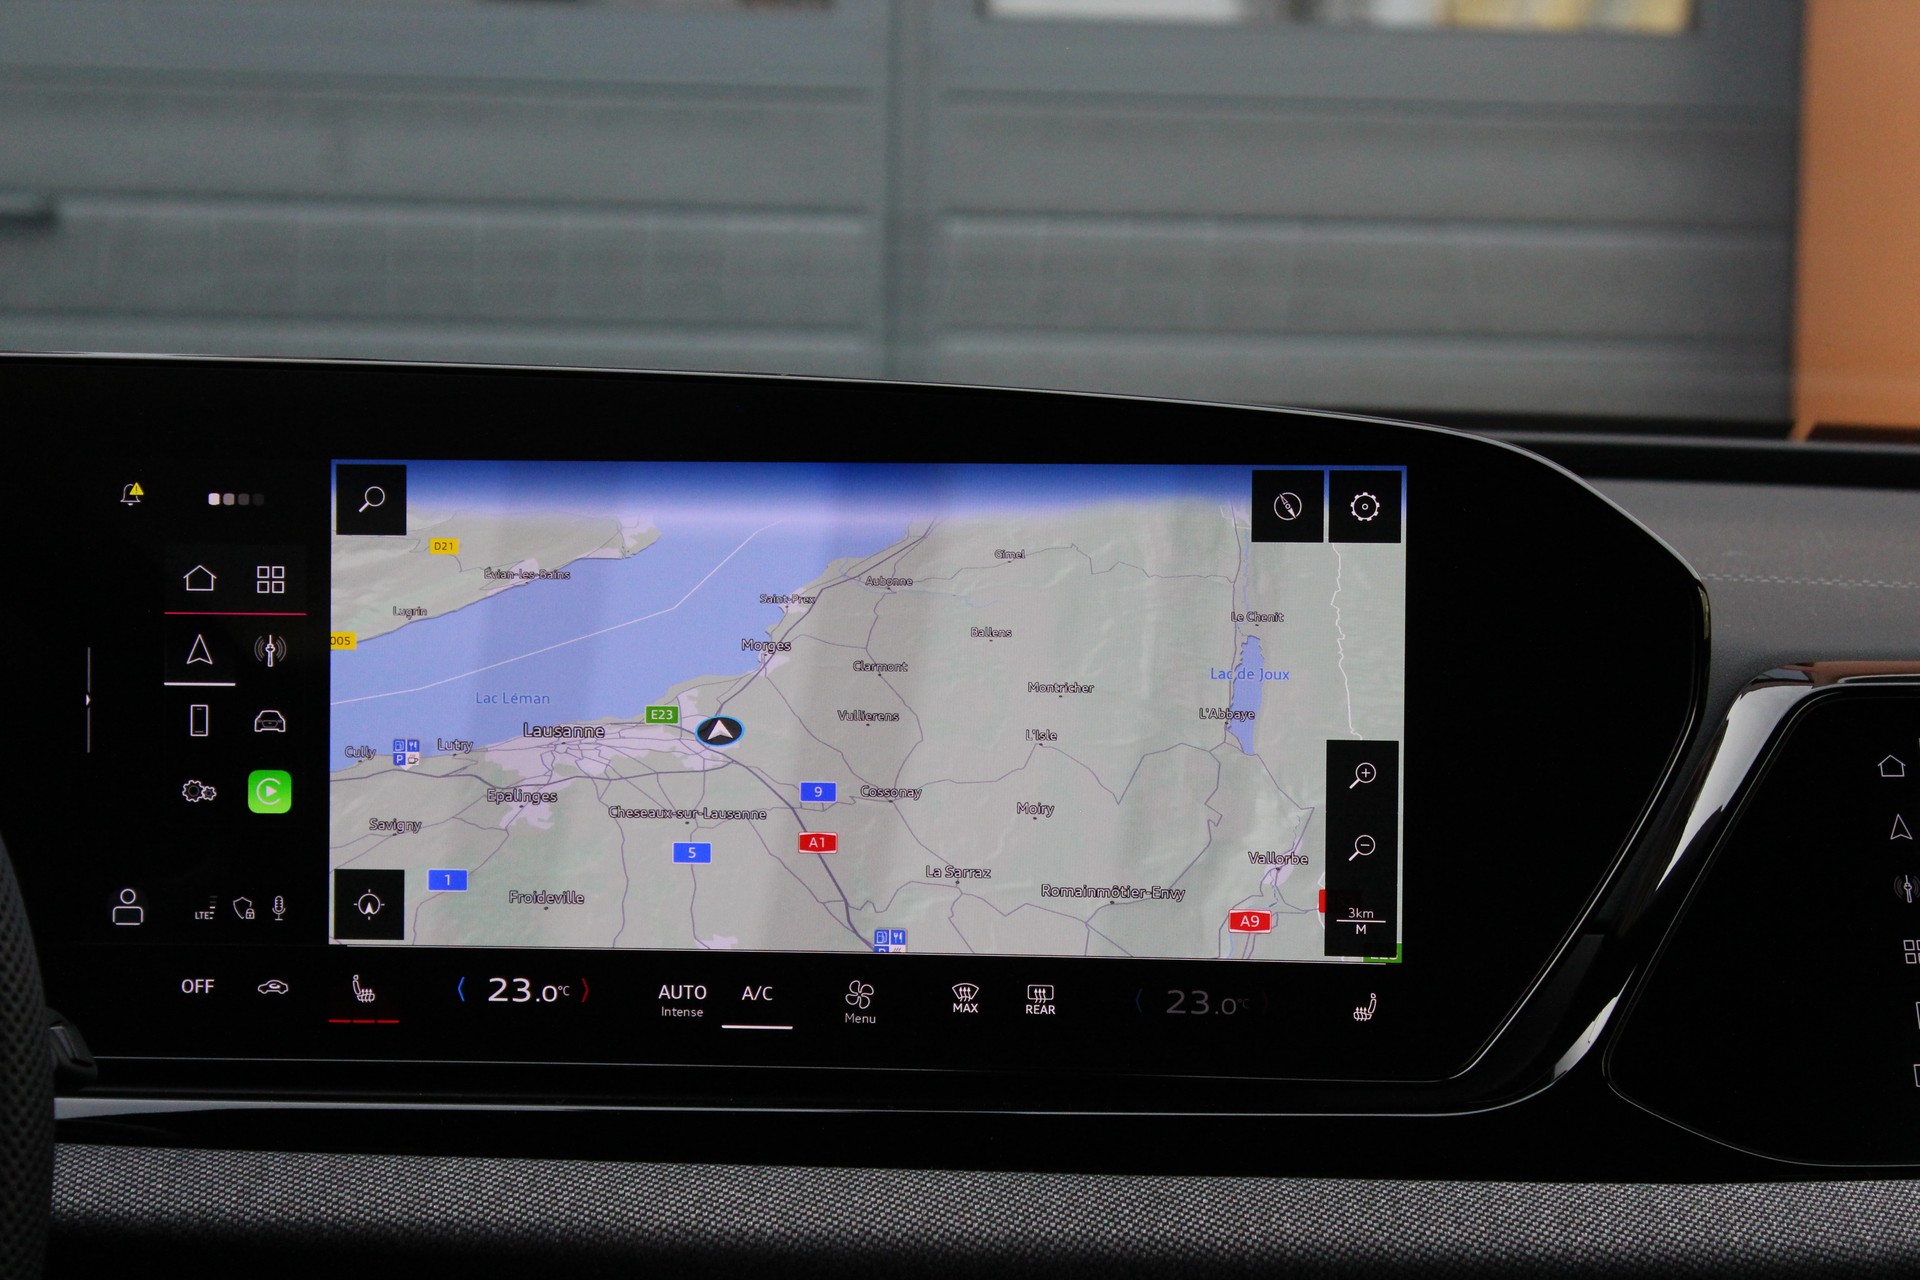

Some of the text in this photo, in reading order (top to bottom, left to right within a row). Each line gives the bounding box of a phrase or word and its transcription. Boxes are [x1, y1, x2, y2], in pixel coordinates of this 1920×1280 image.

[433, 540, 455, 552] D21
[865, 576, 913, 587] Aubonne
[760, 593, 815, 604] Saint-Prex
[392, 606, 428, 619] Lugrin
[1231, 611, 1284, 623] Le Chenit
[970, 626, 1012, 638] Ballens
[741, 639, 792, 654] Morges
[853, 661, 908, 673] Clarmont
[1210, 668, 1290, 683] Lac de Joux
[1027, 681, 1094, 694] Montricher
[475, 691, 551, 705] Lac Léman
[651, 709, 673, 721] E23
[837, 710, 900, 722] Vullierens
[1199, 707, 1255, 722] L'Abbaye
[523, 723, 605, 739] Lausanne
[1025, 729, 1058, 742] L'Isle
[344, 745, 377, 760] Cully
[437, 738, 474, 754] Lutry
[486, 789, 558, 804] Epalinges
[813, 785, 824, 799] 9
[860, 785, 922, 801] Cossonay
[607, 805, 767, 822] Cheseaux-sur-Lausanne
[1016, 802, 1055, 817] Moiry
[369, 818, 422, 834] Savigny
[808, 836, 827, 849] A1
[687, 846, 697, 859] 5
[1248, 851, 1309, 866] Vallorbe
[925, 864, 992, 880] La Sarraz
[509, 890, 585, 905] Froideville
[1041, 883, 1186, 903] Romainmôtier-Envy
[194, 911, 210, 921] LTE
[1347, 907, 1375, 920] 3km
[1239, 914, 1261, 928] A9
[1355, 923, 1367, 936] M
[181, 978, 215, 995] OFF
[658, 984, 708, 1001] AUTO
[741, 985, 774, 1002] A/C
[660, 1006, 704, 1018] Intense
[952, 1002, 979, 1015] MAX
[1024, 1004, 1056, 1016] REAR
[844, 1012, 877, 1025] Menu
